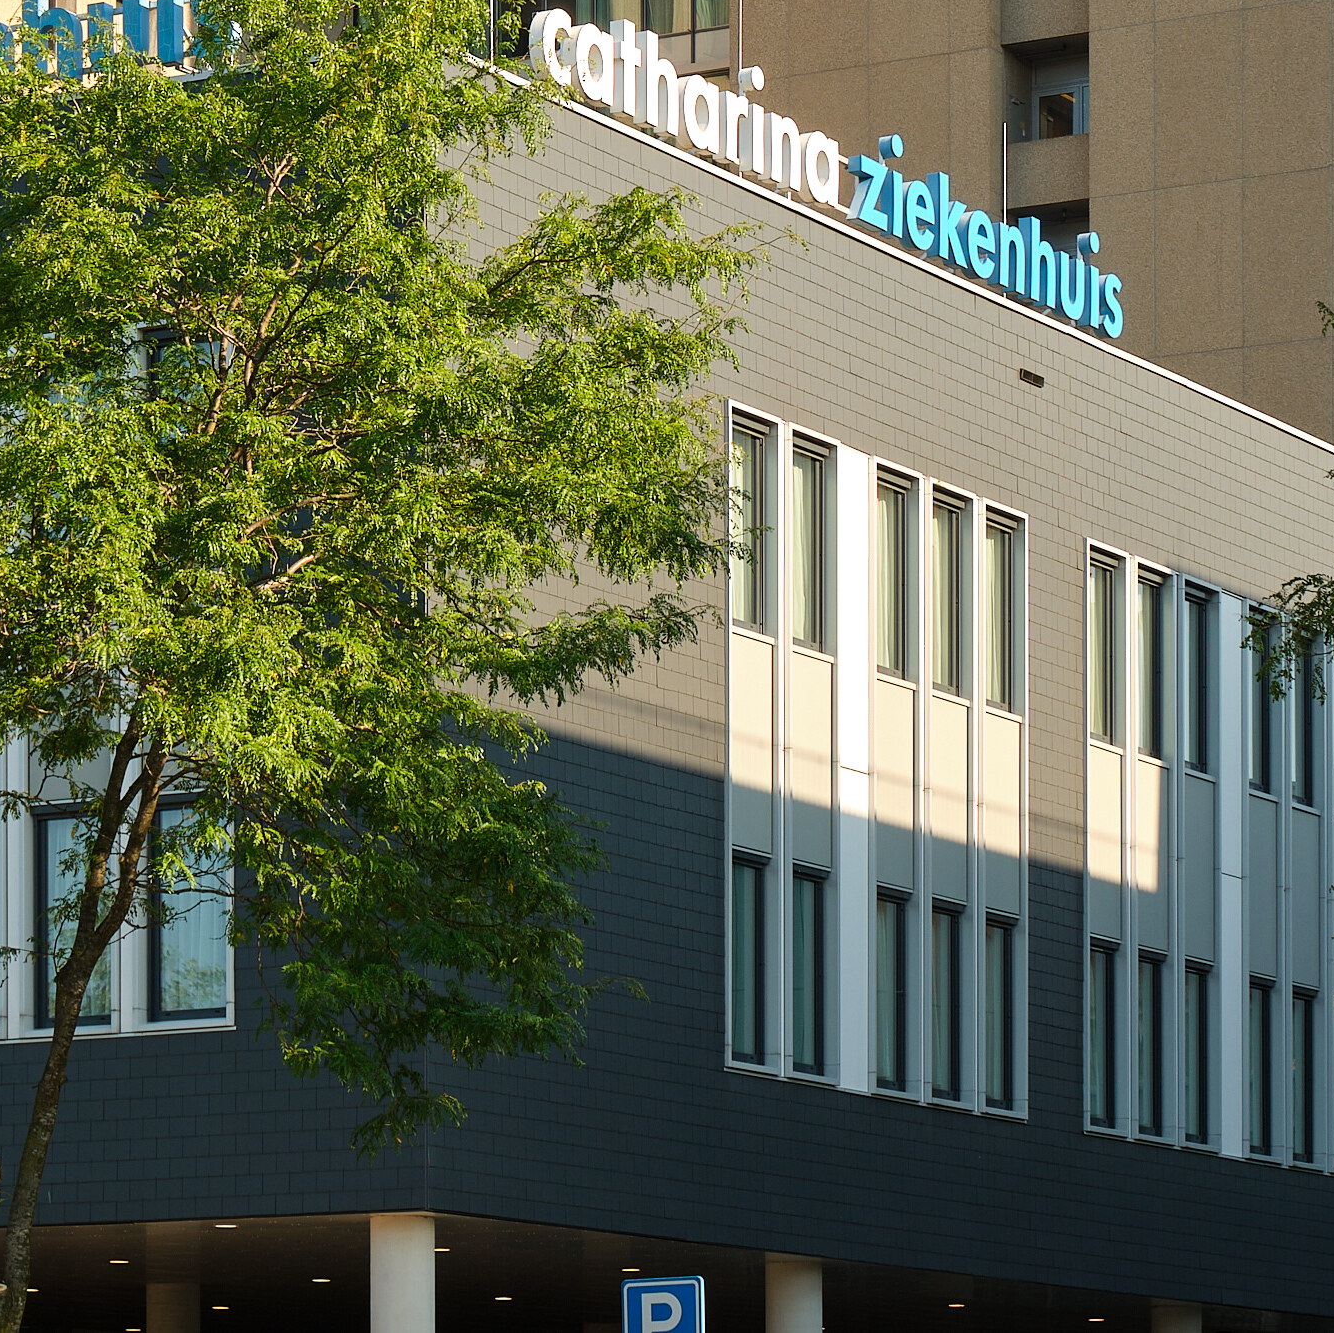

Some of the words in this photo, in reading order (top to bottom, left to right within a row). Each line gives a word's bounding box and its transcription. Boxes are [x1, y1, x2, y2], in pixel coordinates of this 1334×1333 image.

[529, 7, 840, 209] catharina
[846, 133, 1124, 339] ziekenhuis
[641, 1292, 682, 1333] P
